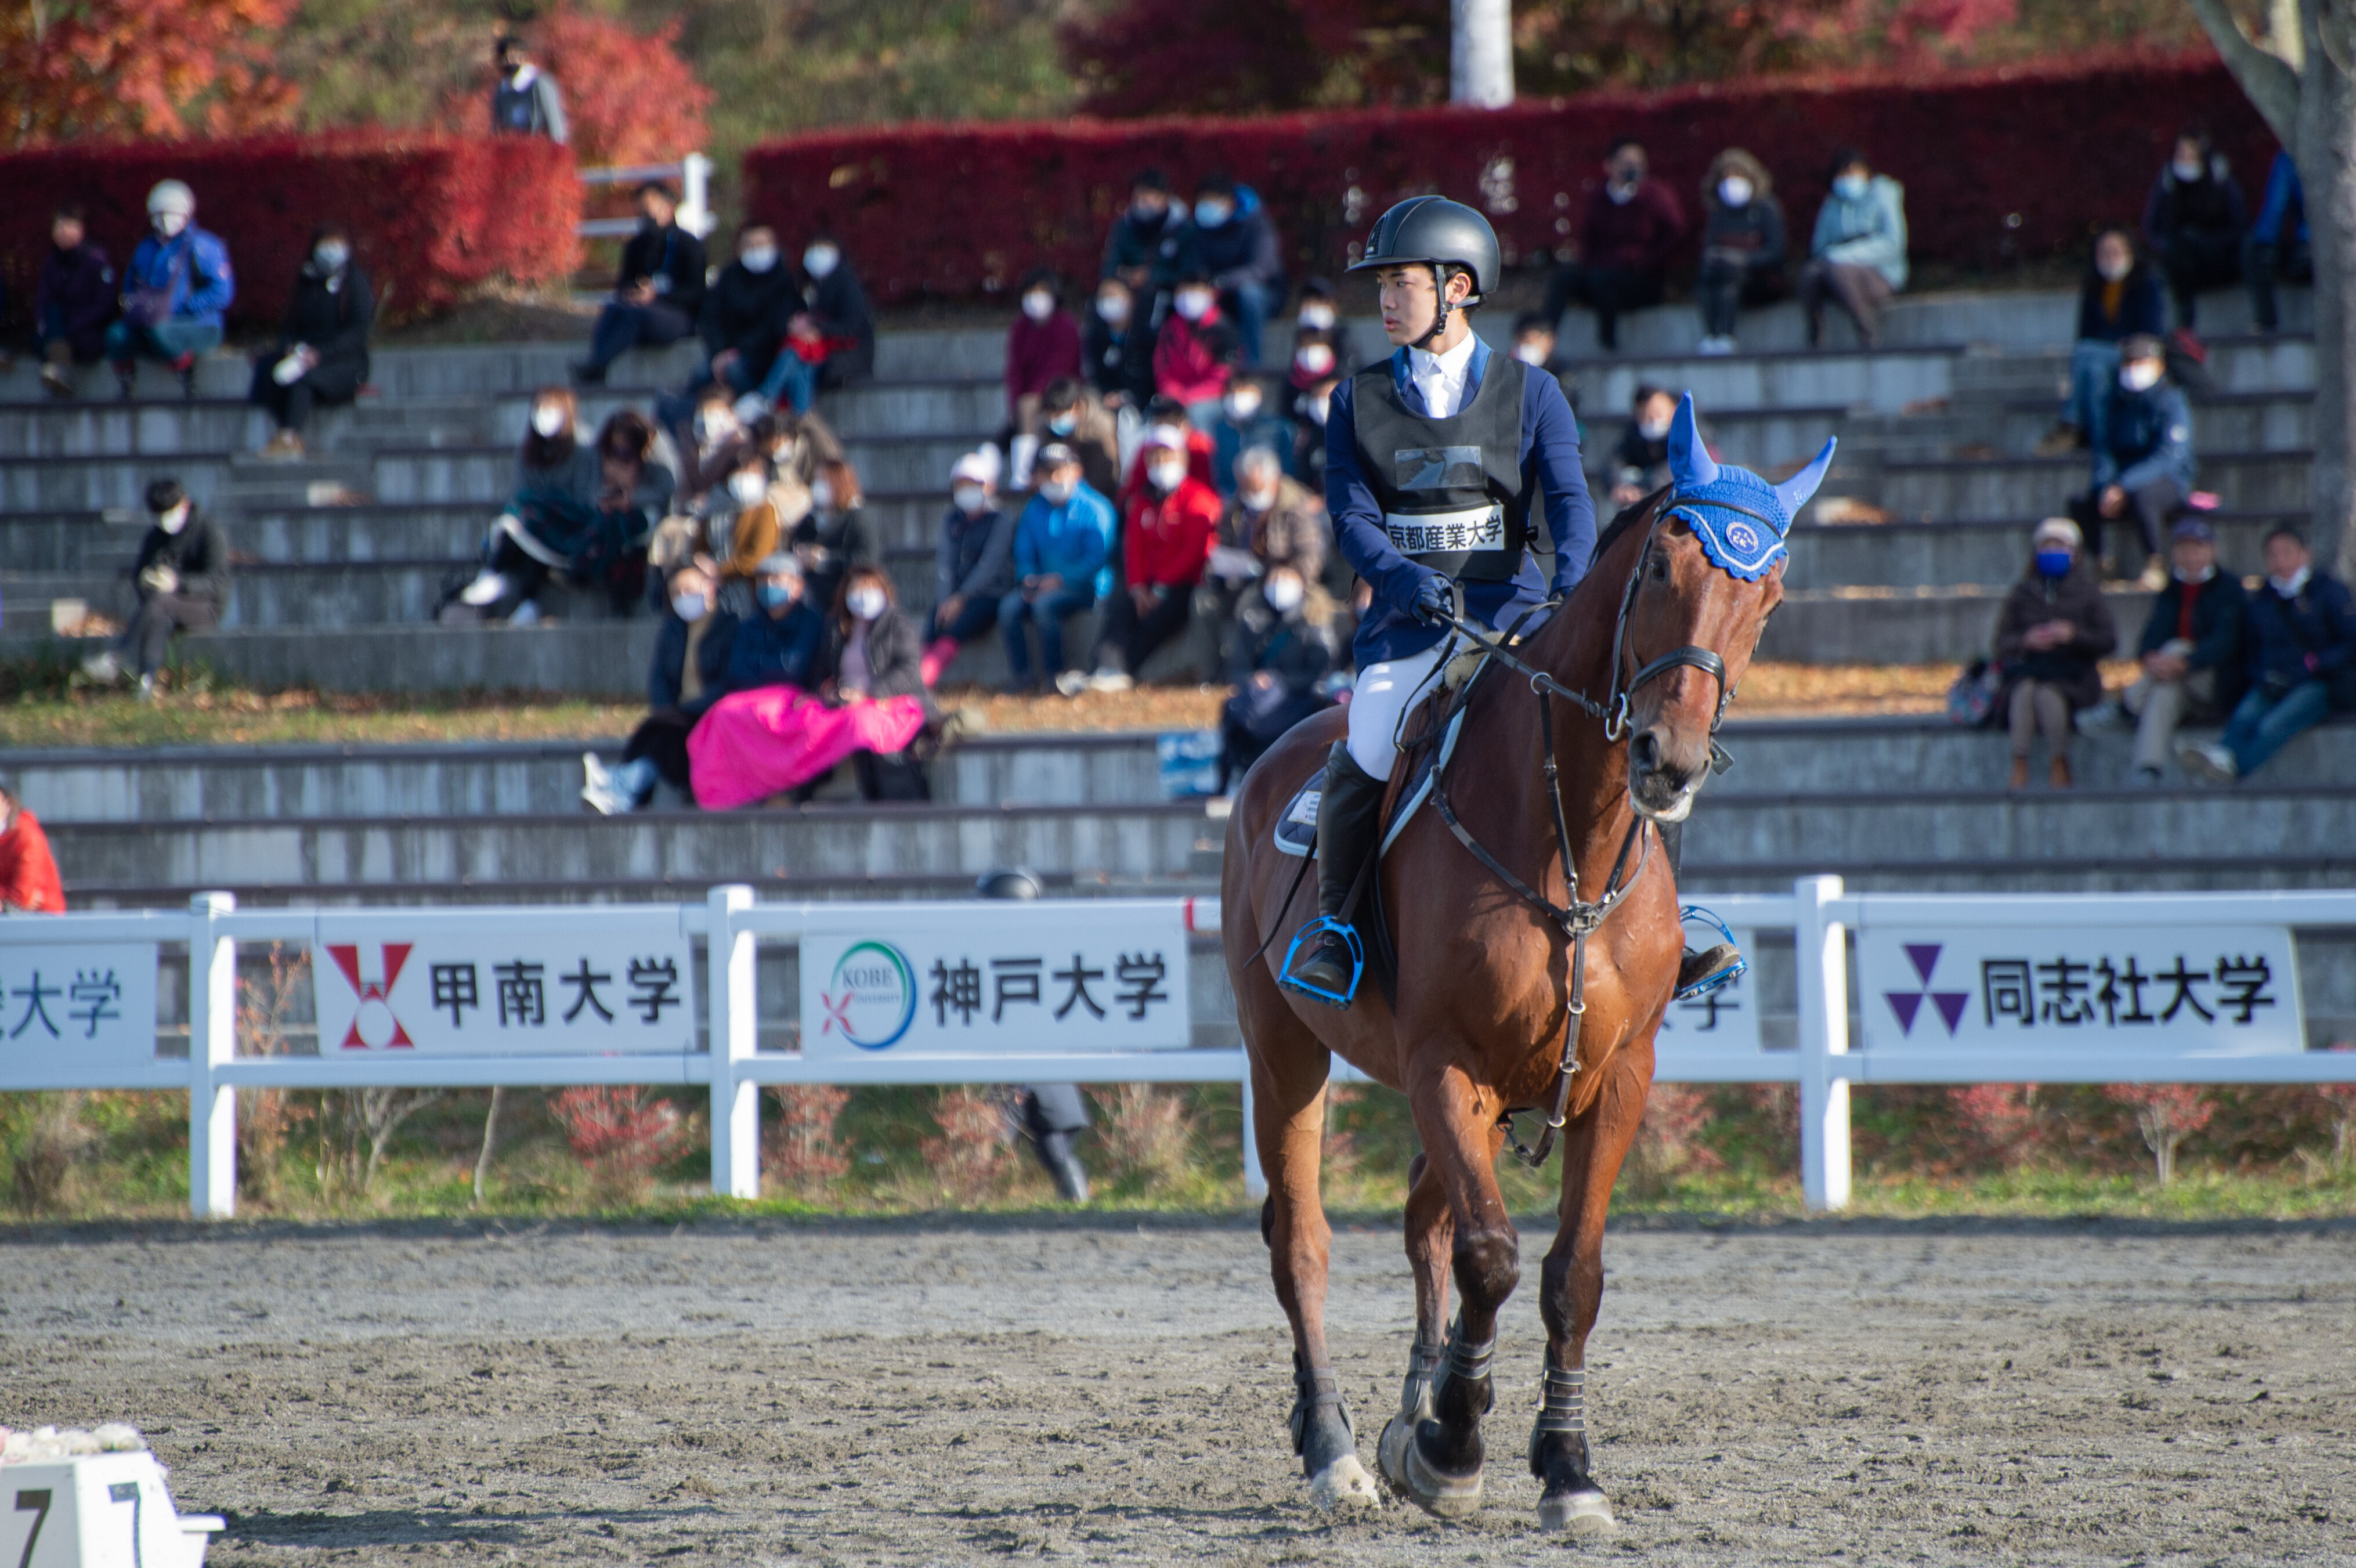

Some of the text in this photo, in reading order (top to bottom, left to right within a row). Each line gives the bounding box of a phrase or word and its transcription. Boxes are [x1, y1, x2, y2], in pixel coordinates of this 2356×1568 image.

[1387, 514, 1503, 551] 京都産業大学
[0, 969, 121, 1040] 大学
[429, 956, 681, 1028] 甲南大学
[842, 968, 893, 989] KOBE
[929, 951, 1168, 1027] 神戸大学
[1982, 956, 2274, 1026] 同志社大学
[15, 1489, 53, 1568] 7
[107, 1481, 141, 1568] 7
